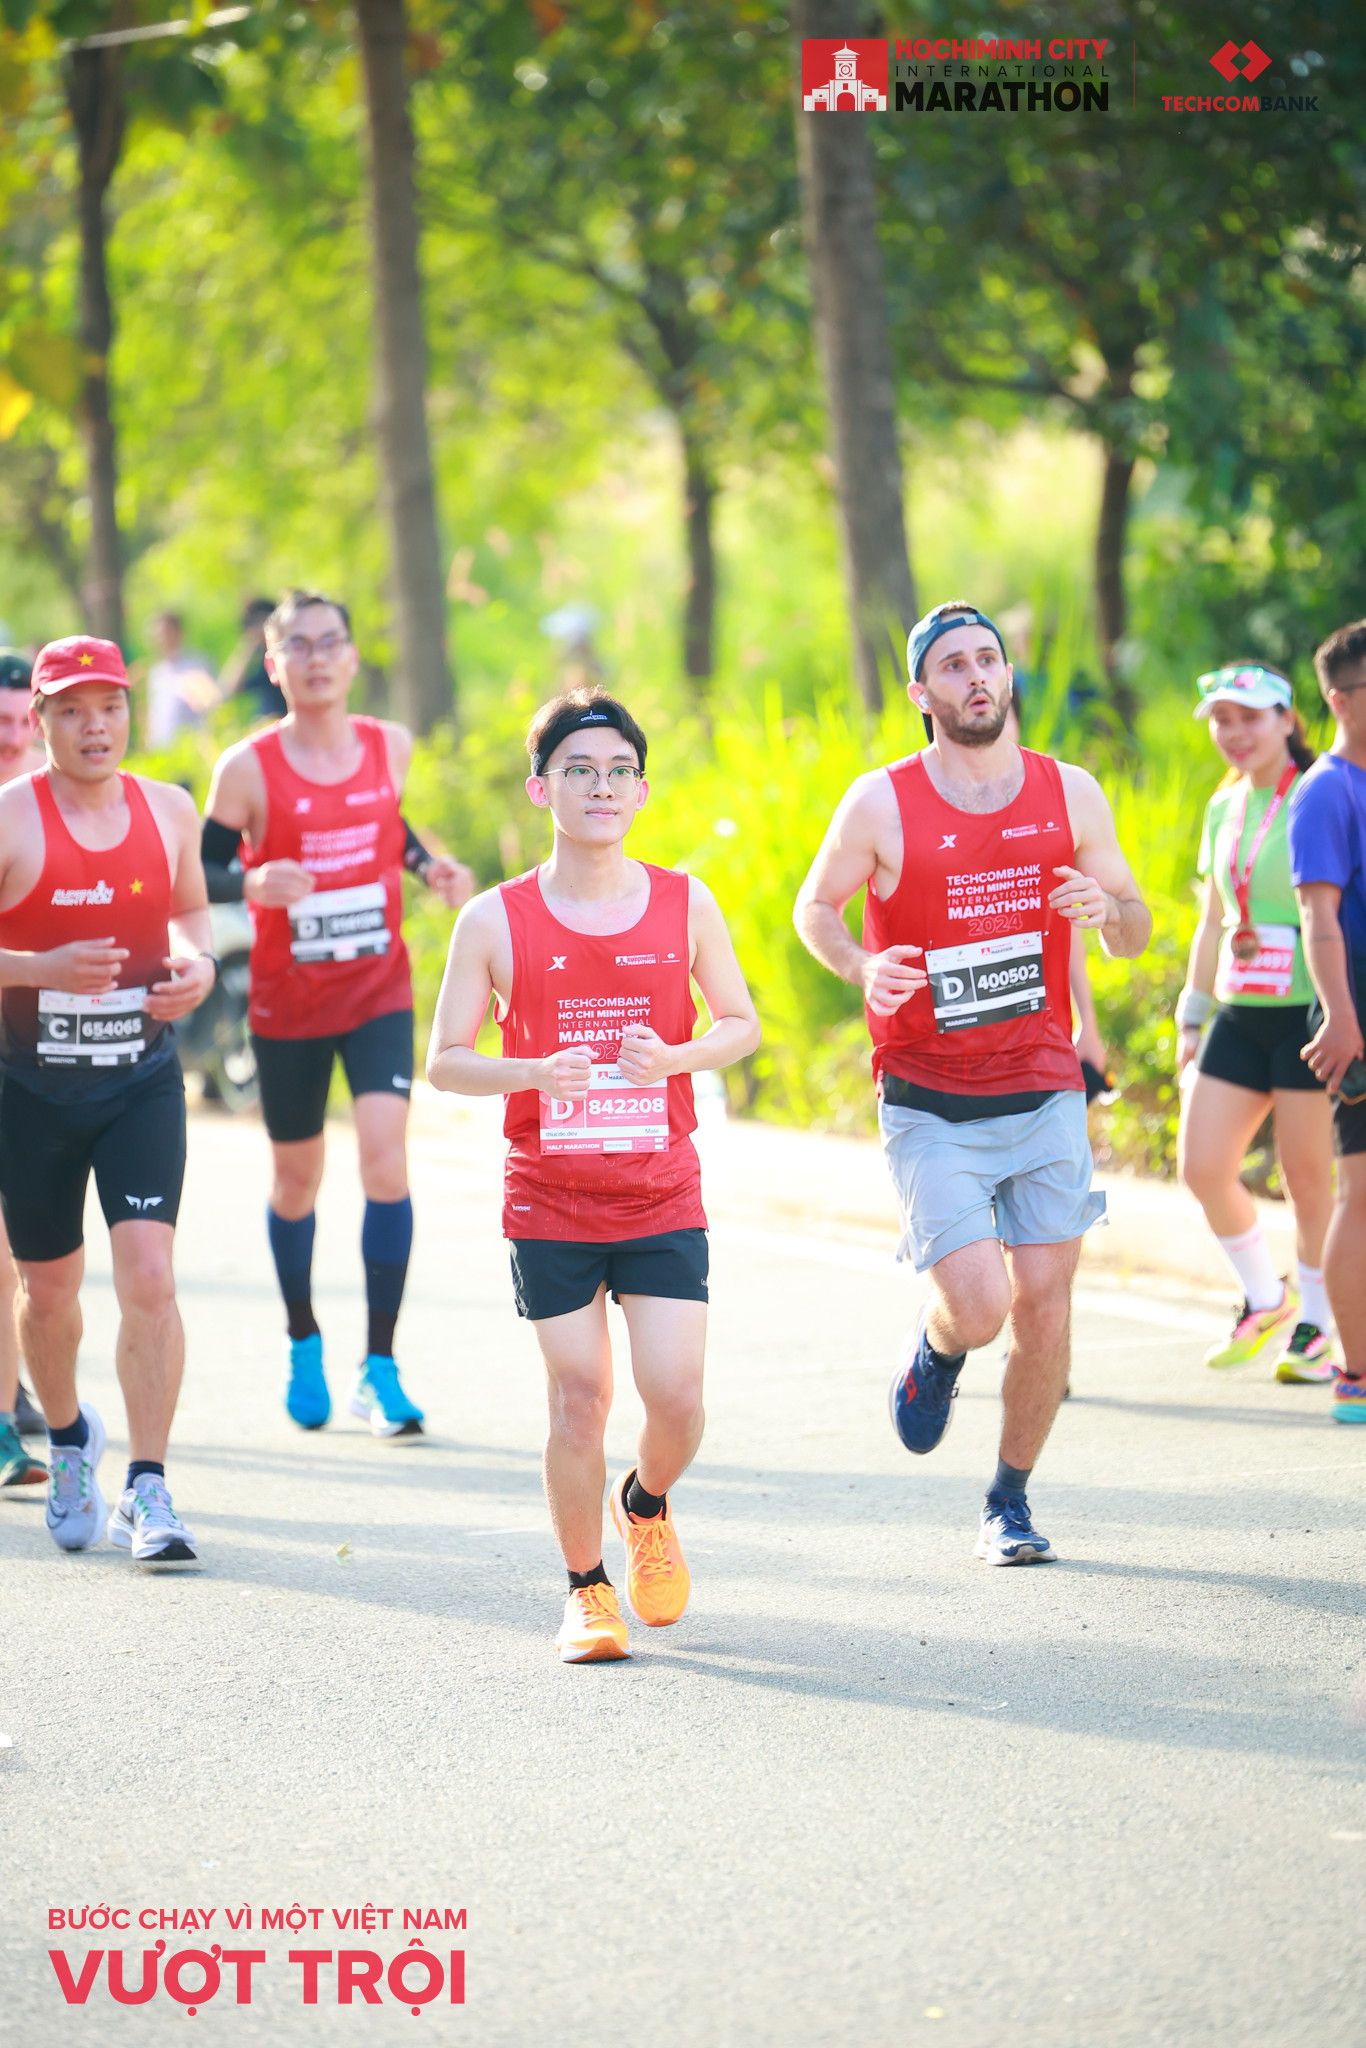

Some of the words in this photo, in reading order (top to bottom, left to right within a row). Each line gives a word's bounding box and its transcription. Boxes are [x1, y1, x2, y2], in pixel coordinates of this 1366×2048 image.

[946, 864, 1041, 886] TECHCOMBANK
[947, 887, 964, 897] HO
[965, 885, 984, 895] CHI
[987, 881, 1015, 893] MINH
[1017, 877, 1041, 889] CITY
[947, 887, 1041, 906] INTERNATIONAL
[948, 897, 1041, 920] MARATHON
[968, 914, 1023, 936] 2024
[941, 977, 964, 1000] D
[978, 963, 1039, 990] 400502
[557, 996, 651, 1009] TECHCOMBANK
[558, 1011, 573, 1020] HO
[575, 1010, 594, 1018] CHI
[597, 1009, 624, 1018] MINH
[627, 1008, 651, 1017] CITY
[48, 1018, 69, 1040] C
[551, 1097, 574, 1120] D
[588, 1098, 665, 1115] 842208
